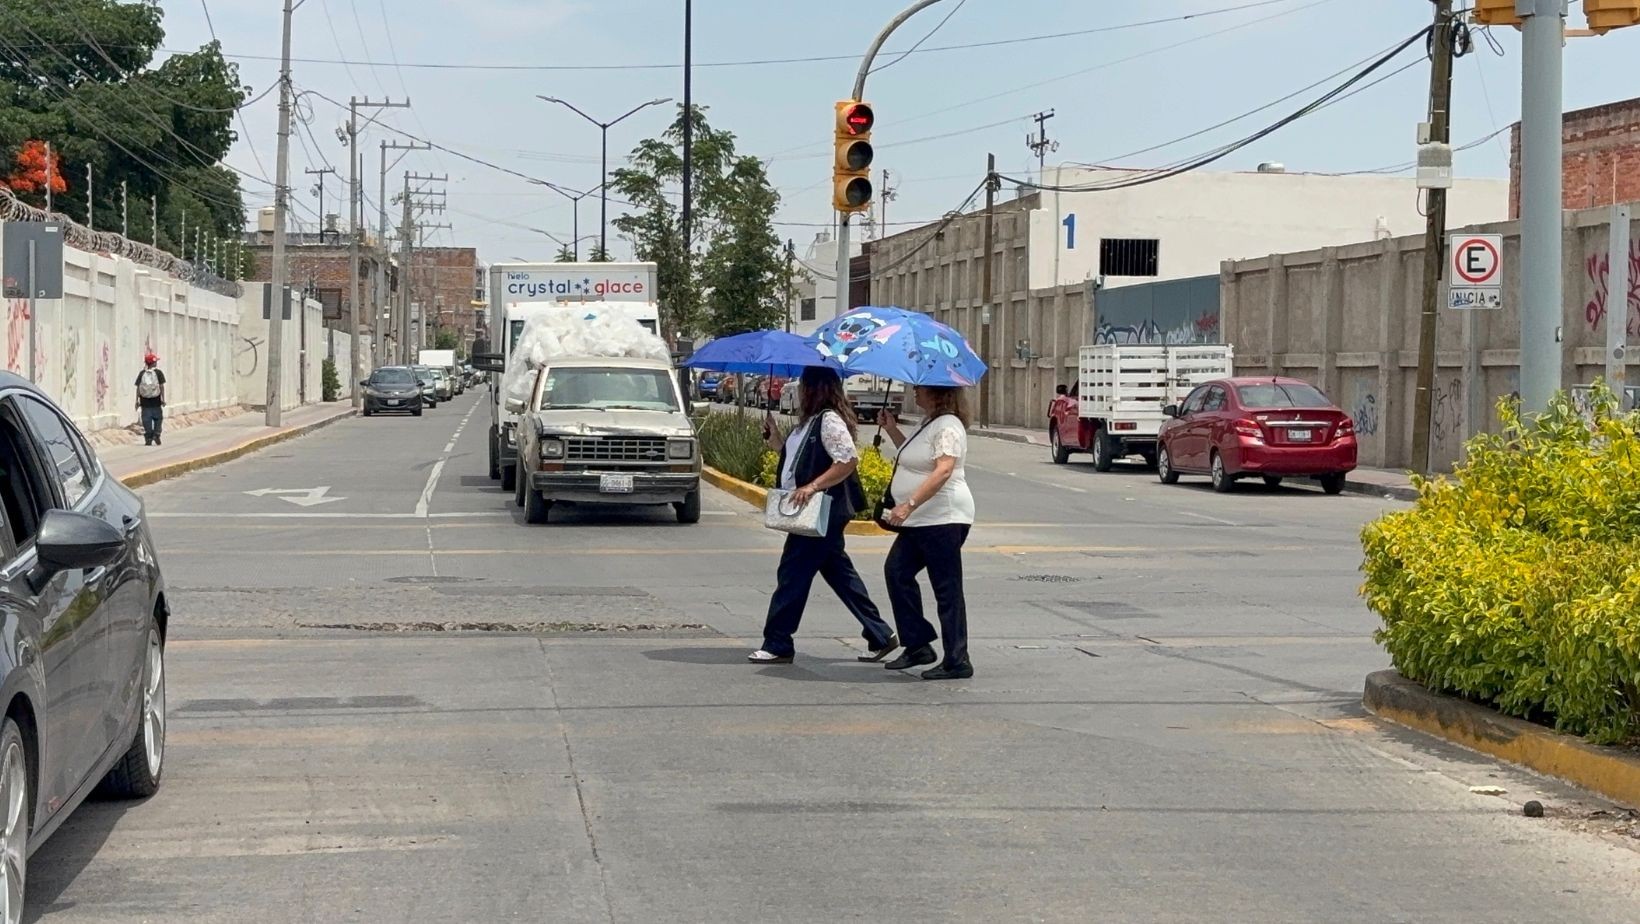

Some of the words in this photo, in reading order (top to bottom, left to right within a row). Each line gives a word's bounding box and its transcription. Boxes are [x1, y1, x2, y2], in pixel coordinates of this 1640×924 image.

[1062, 213, 1075, 249] 1
[1467, 246, 1486, 273] E
[508, 279, 571, 297] crystal
[594, 279, 643, 297] glace
[1452, 292, 1486, 305] INICIA
